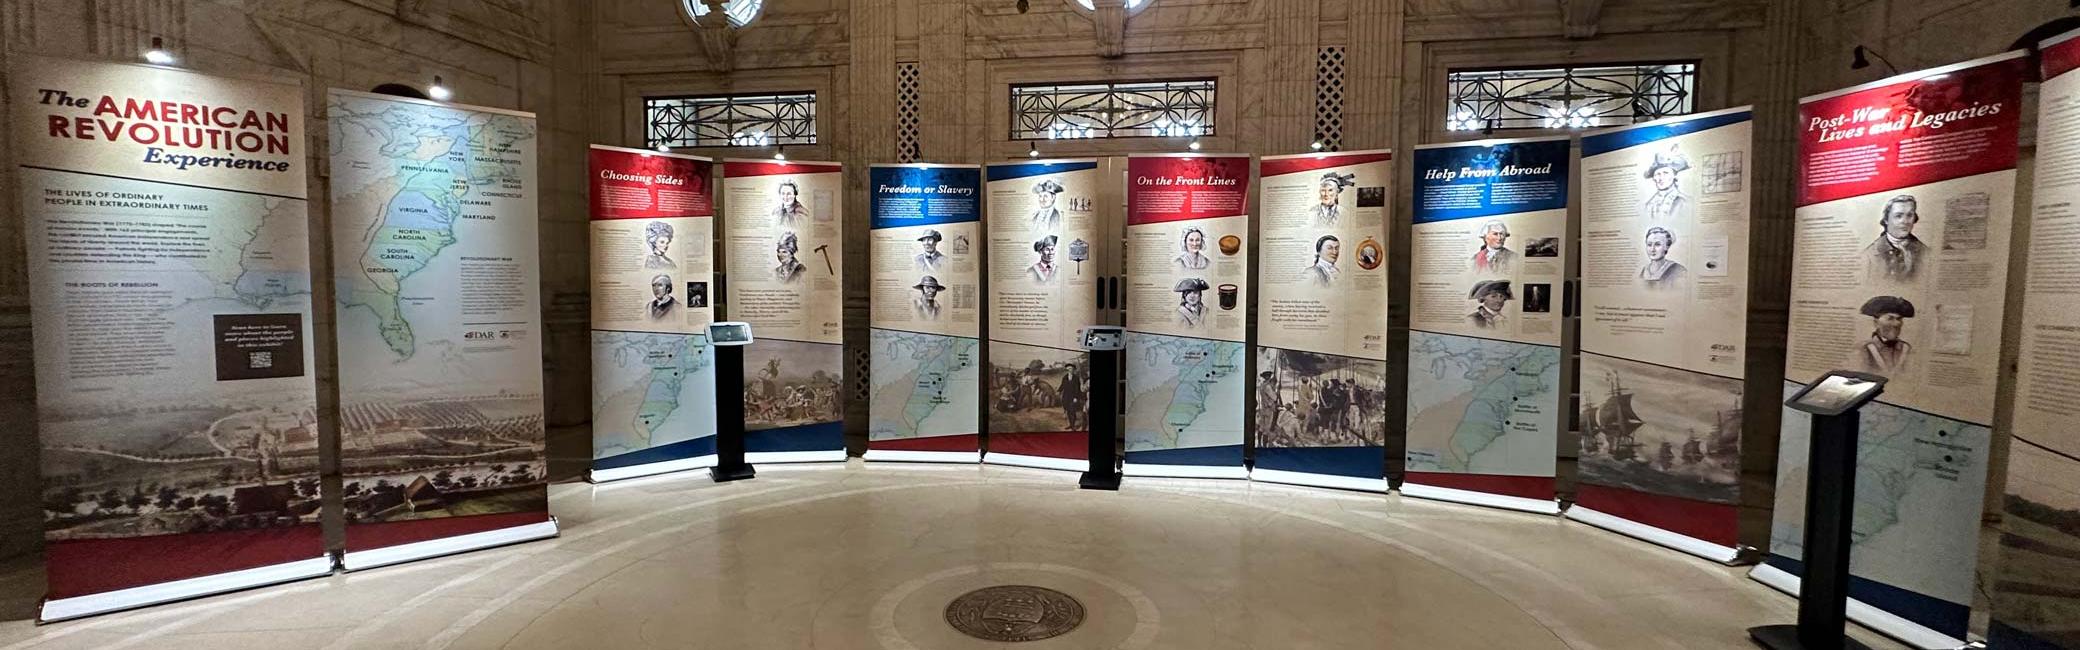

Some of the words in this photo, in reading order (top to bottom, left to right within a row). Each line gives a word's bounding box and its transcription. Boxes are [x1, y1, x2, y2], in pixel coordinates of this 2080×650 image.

[38, 89, 90, 108] The
[93, 95, 288, 133] AMERICAN
[1808, 106, 1893, 132] Post-War
[1818, 125, 1865, 143] Lives
[1868, 115, 1906, 135] and
[1910, 101, 2002, 129] Legacies
[48, 114, 289, 155] REVOLUTION
[143, 147, 289, 172] Experience
[400, 165, 449, 174] PENNSYLVANIA
[600, 168, 653, 185] Choosing
[655, 174, 684, 186] Sides
[1424, 168, 1456, 181] Help
[1459, 166, 1497, 179] From
[1499, 162, 1553, 177] Abroad
[1137, 175, 1153, 186] On
[1155, 176, 1173, 186] the
[1175, 175, 1205, 186] Front
[1207, 176, 1237, 186] Lines
[66, 190, 92, 198] LIVES
[95, 191, 110, 199] OF
[112, 192, 164, 201] ORDINARY
[879, 184, 922, 194] Freedom
[924, 186, 936, 194] or
[937, 184, 974, 196] Slavery
[45, 198, 85, 206] PEOPLE
[86, 199, 96, 207] IN
[100, 200, 180, 210] EXTRAORDINARY
[474, 331, 496, 339] DAR
